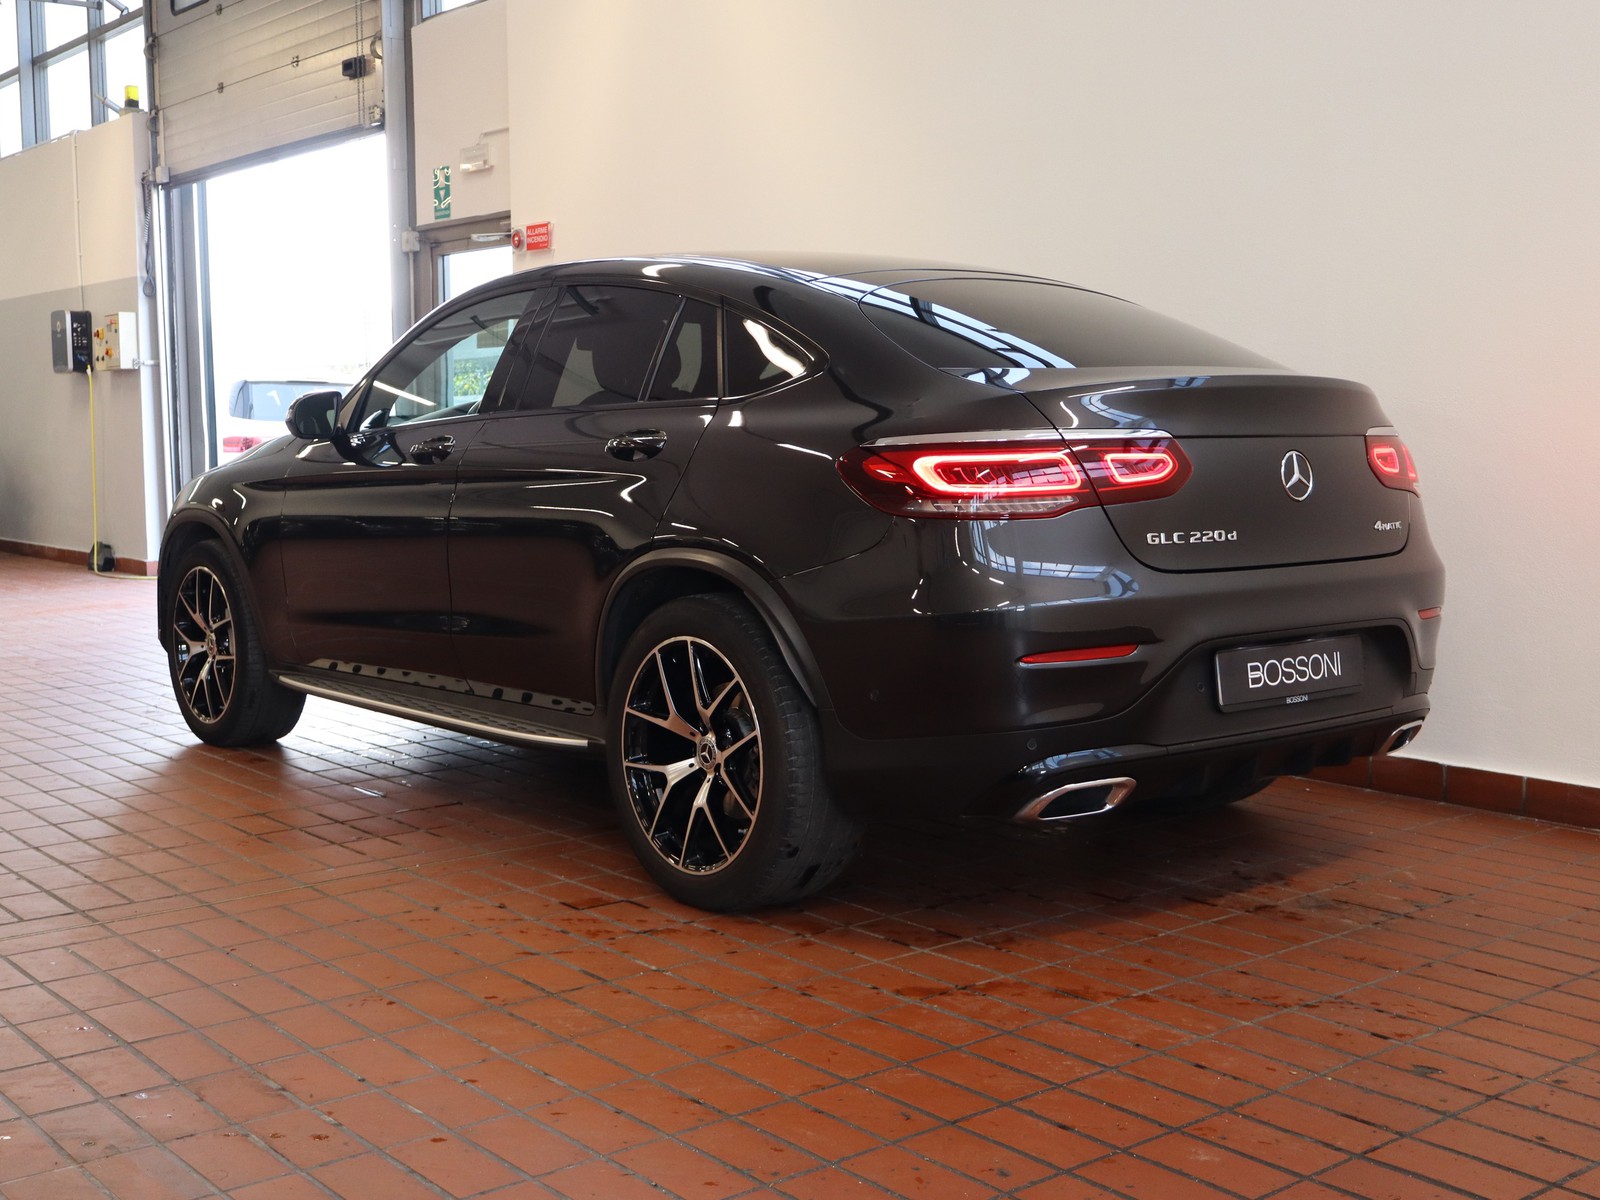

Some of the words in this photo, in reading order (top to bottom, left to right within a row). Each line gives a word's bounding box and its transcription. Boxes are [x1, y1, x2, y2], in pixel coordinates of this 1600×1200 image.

[527, 226, 548, 235] ALLARME
[527, 234, 549, 243] INCENDIO
[1374, 520, 1402, 531] 4MATIC
[1146, 532, 1185, 544] GLC
[1189, 530, 1238, 543] 220d
[1247, 651, 1342, 688] BOSSONI
[1286, 694, 1308, 704] BOSSONI
